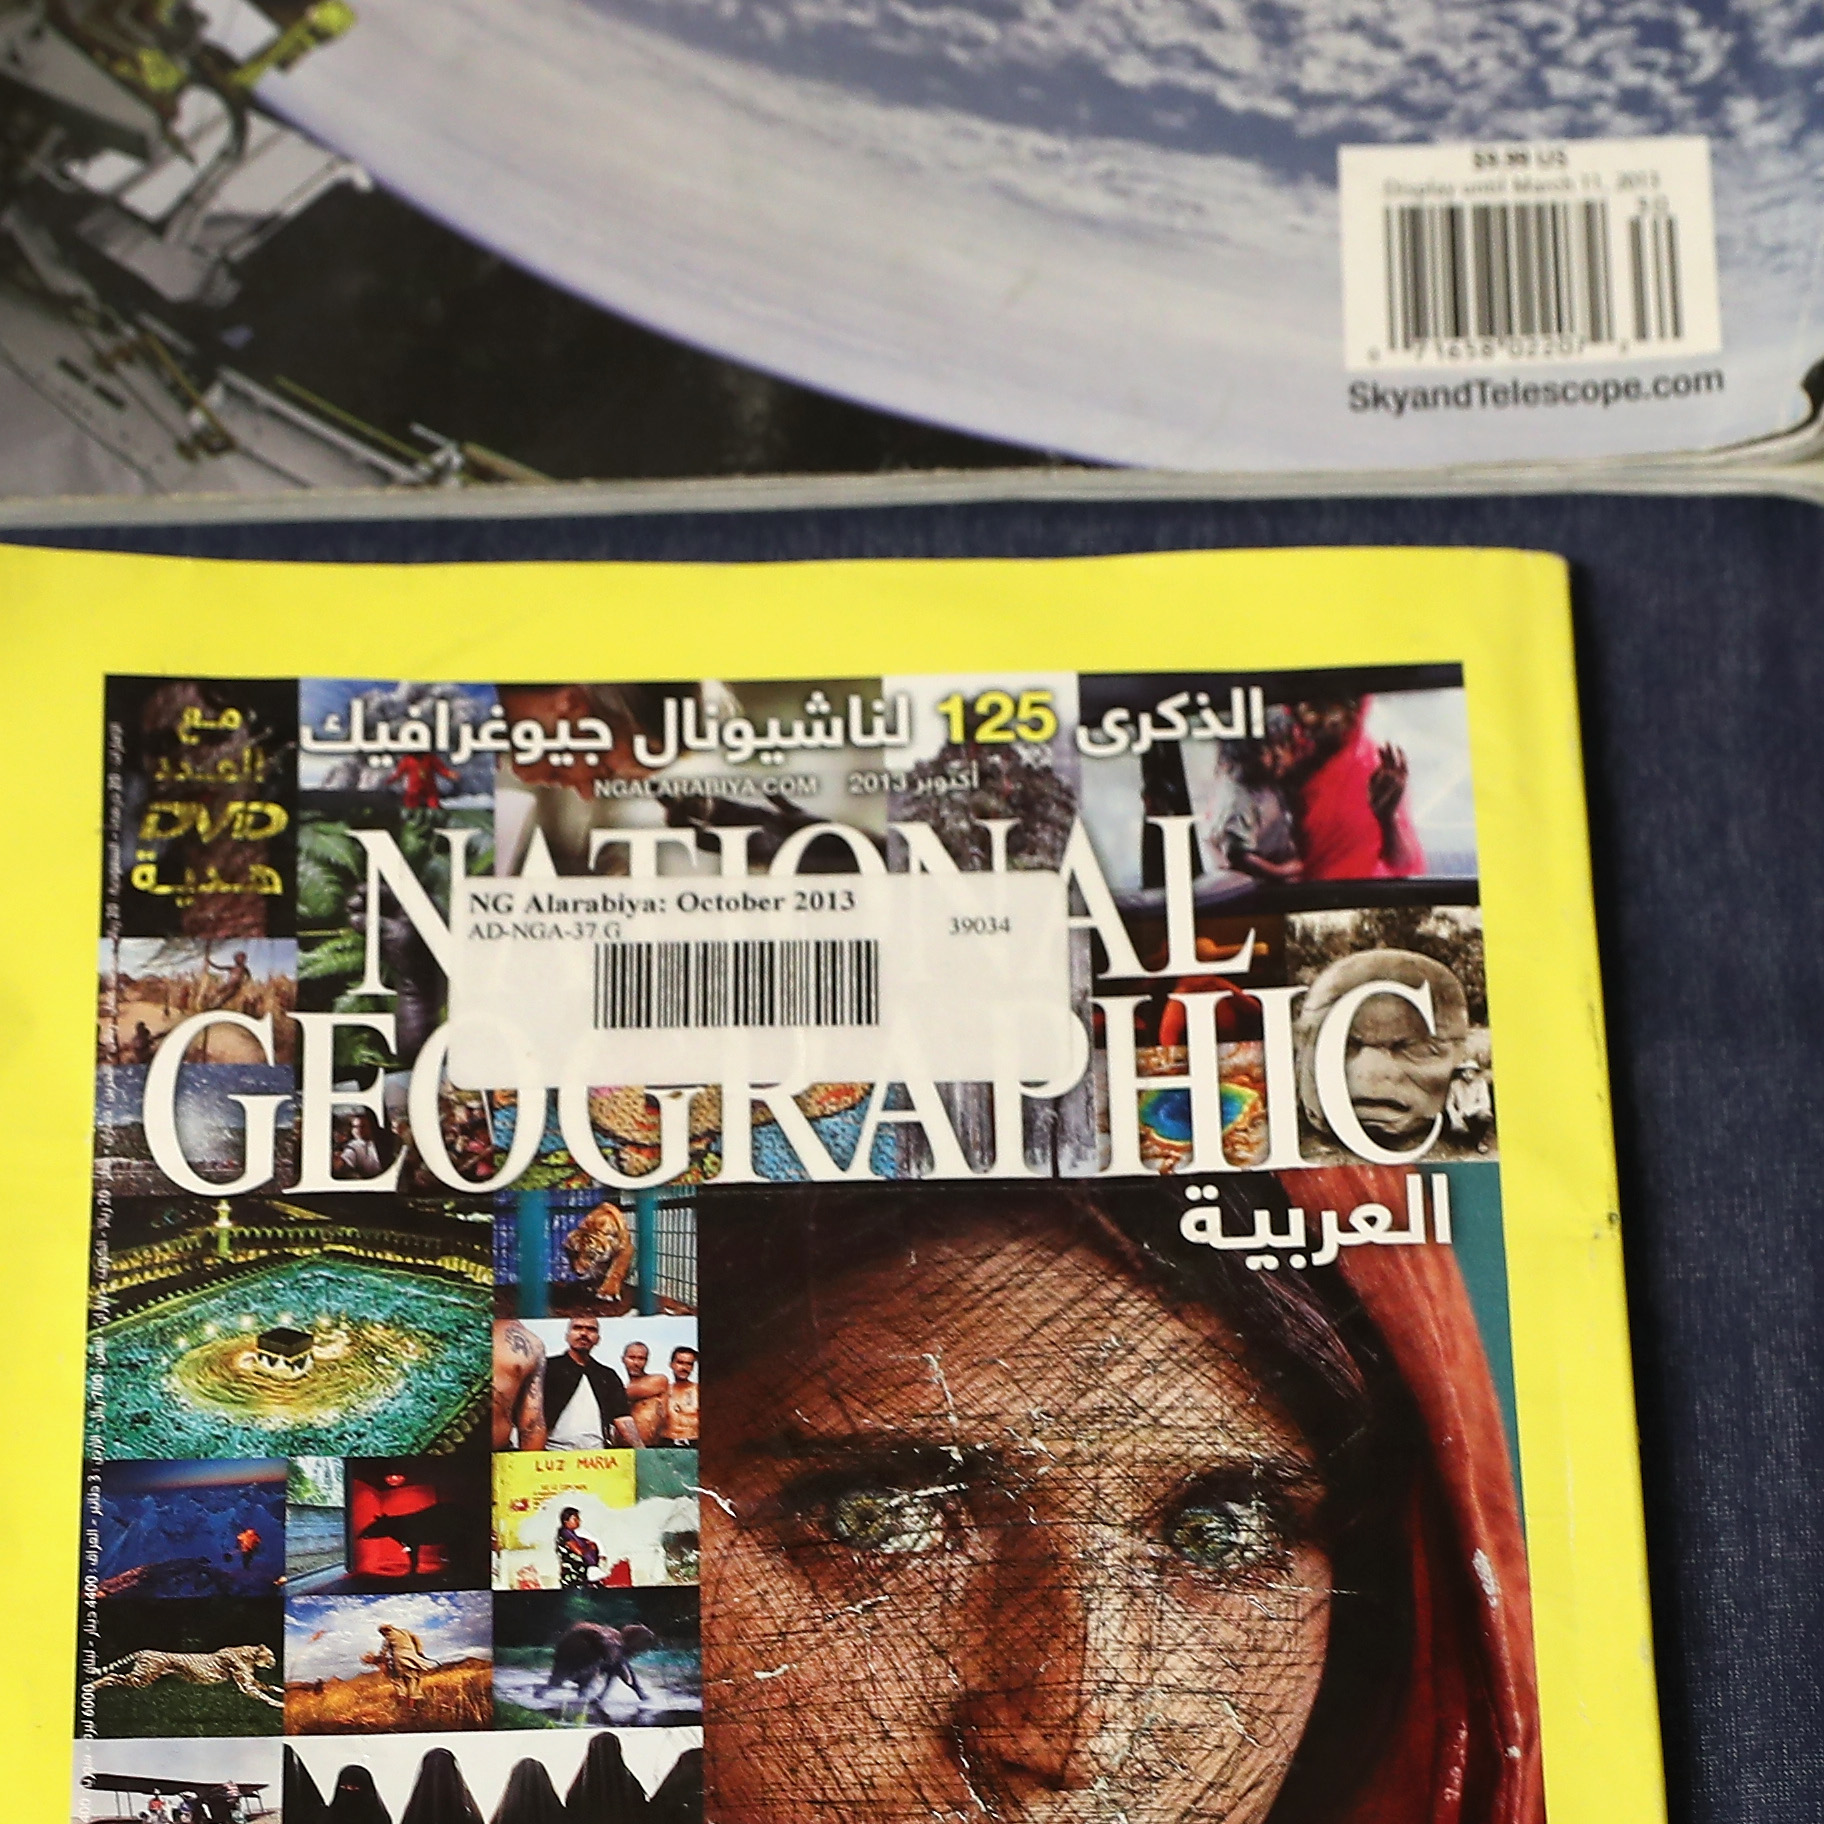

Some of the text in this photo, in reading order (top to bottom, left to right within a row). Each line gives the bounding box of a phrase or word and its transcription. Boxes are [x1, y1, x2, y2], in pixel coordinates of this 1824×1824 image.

[1348, 369, 1725, 418] SkyandTelescope.com
[154, 707, 265, 783] مع العدد
[299, 686, 1267, 771] الذكرى 125 لناشيونال جيوغرافيك
[848, 769, 914, 796] 2013
[138, 801, 290, 844] DVD
[131, 850, 284, 908] هدية
[469, 888, 856, 919] NG Alarabiya: October 2013
[948, 916, 1011, 936] 39034
[1177, 1173, 1453, 1270] العربية
[535, 1459, 566, 1473] LUZ
[84, 1529, 103, 1564] العراق
[83, 1577, 102, 1610] 4400
[80, 1686, 98, 1718] 6000
